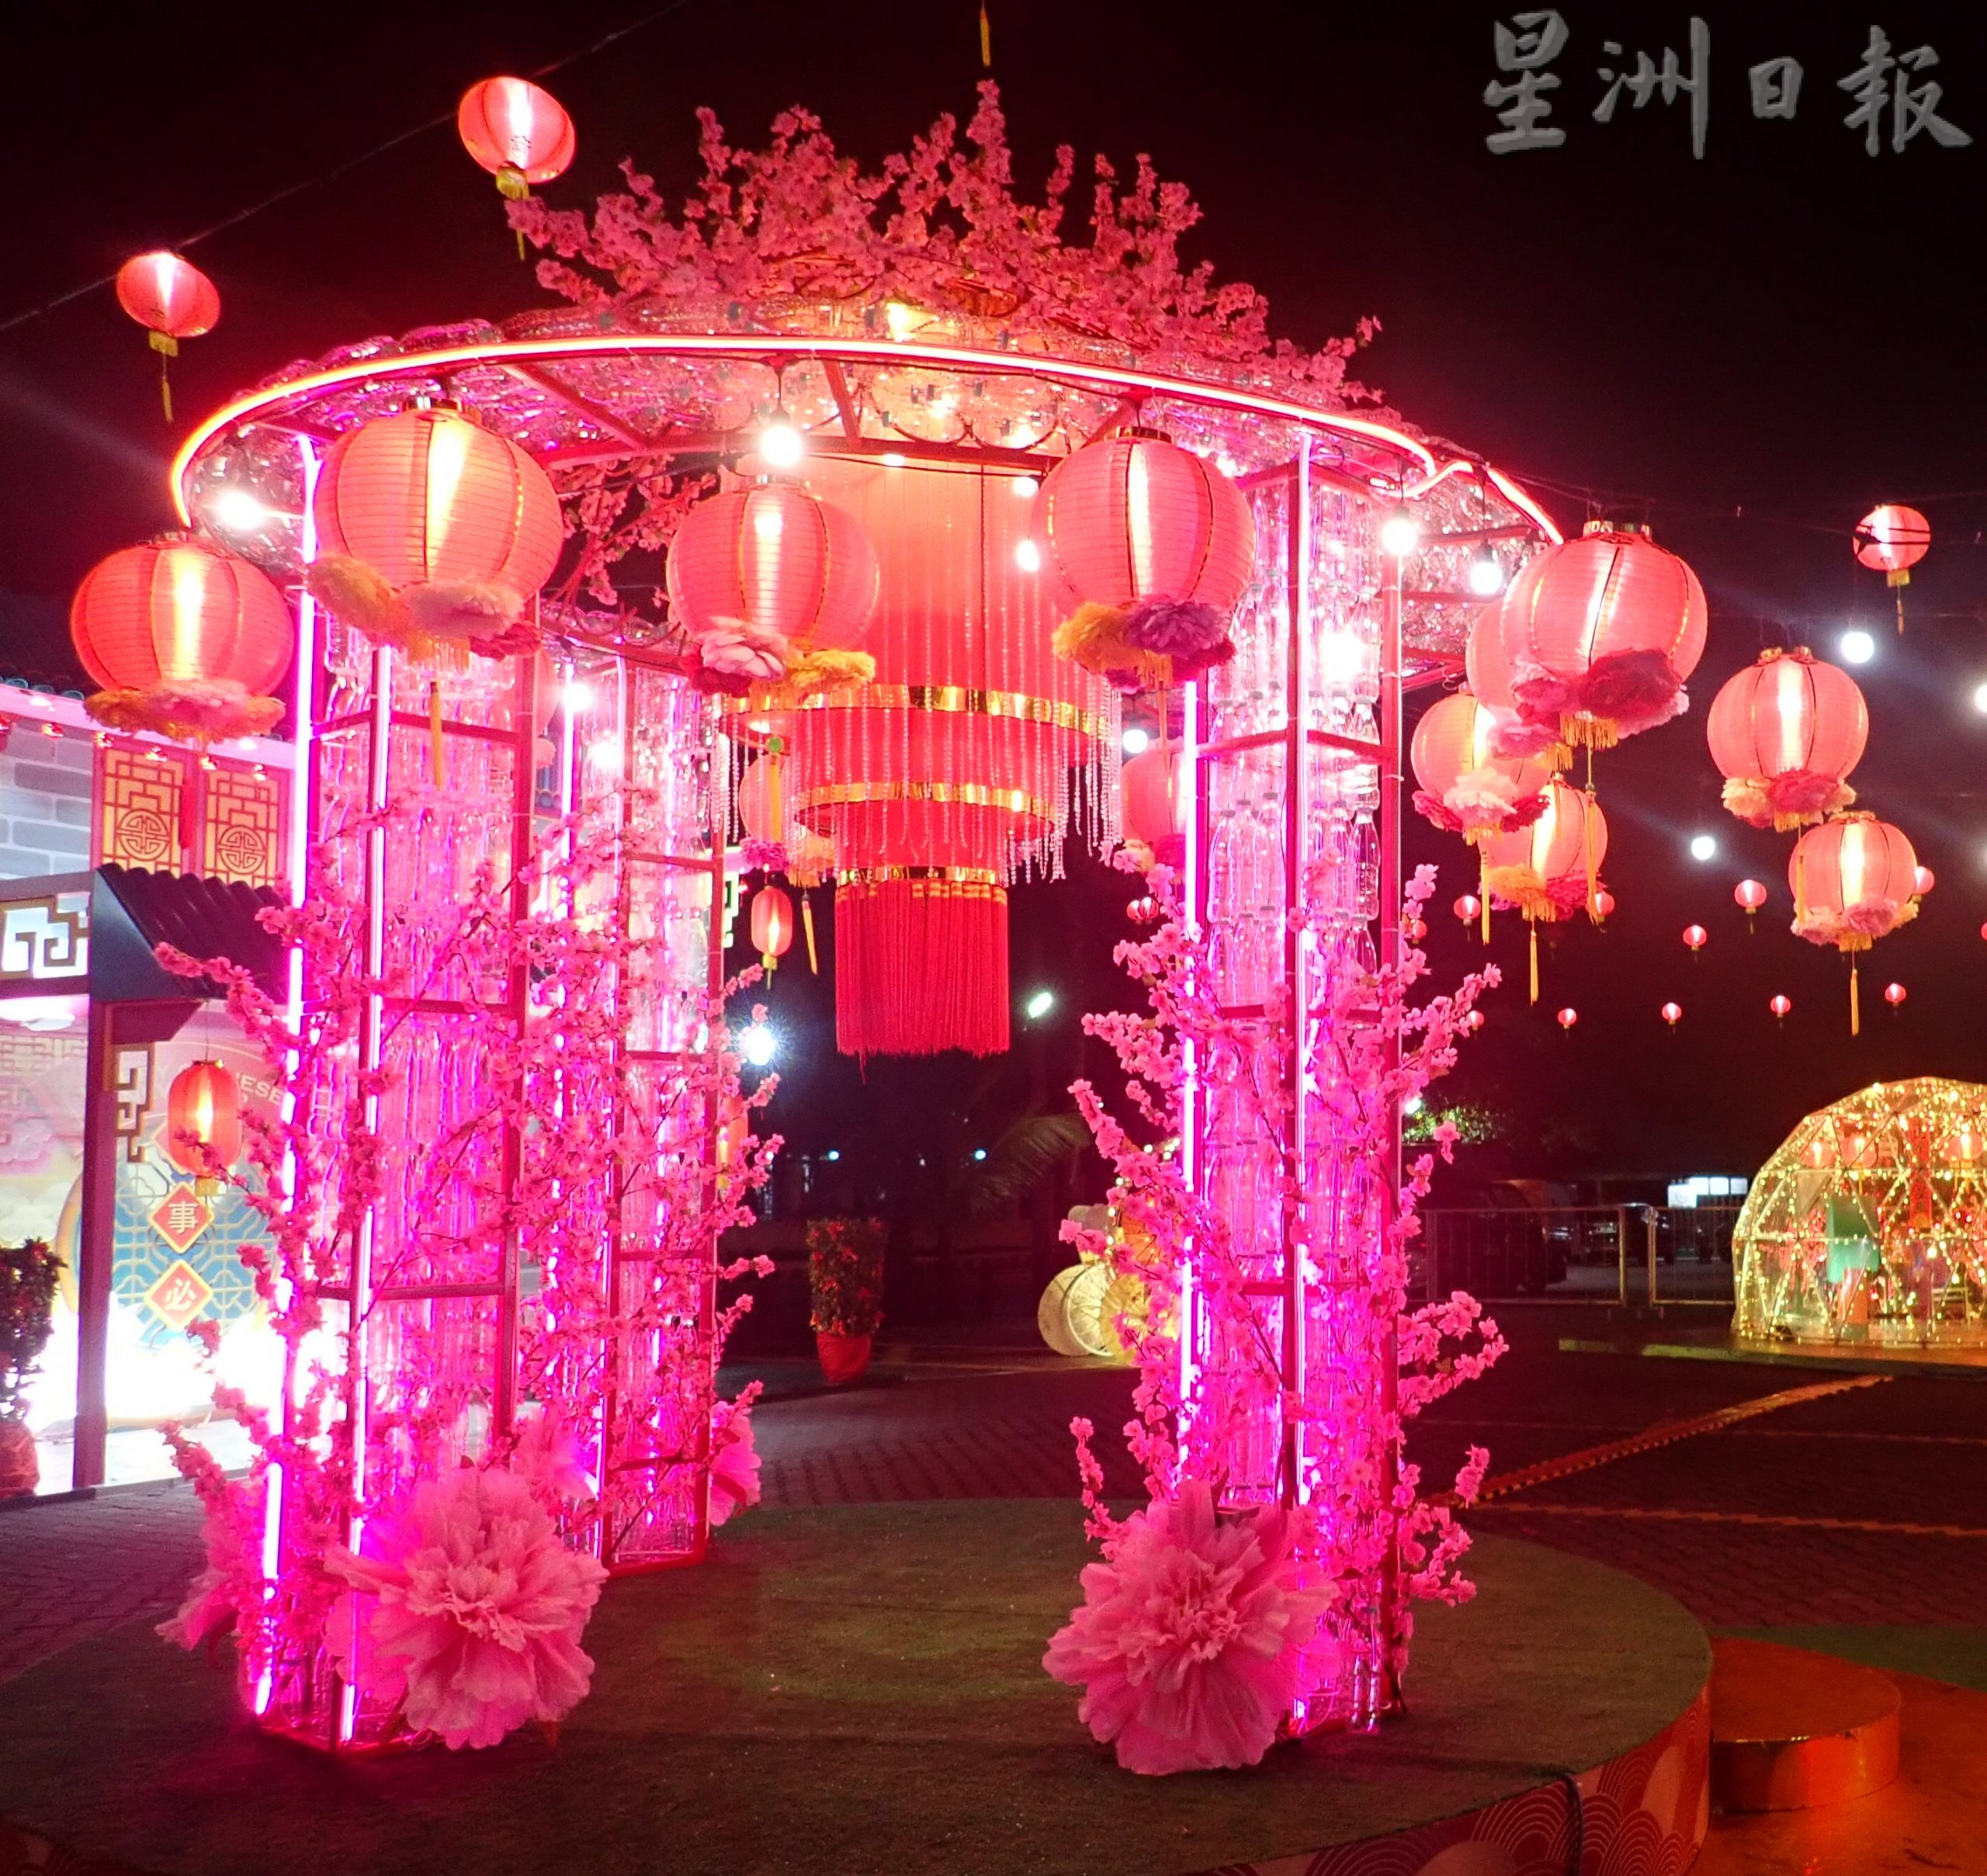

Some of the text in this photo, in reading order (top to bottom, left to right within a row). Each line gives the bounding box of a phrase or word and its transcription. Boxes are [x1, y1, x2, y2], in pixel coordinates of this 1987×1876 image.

[235, 1072, 283, 1106] ESE
[168, 1201, 199, 1234] 事
[165, 1278, 197, 1311] 必
